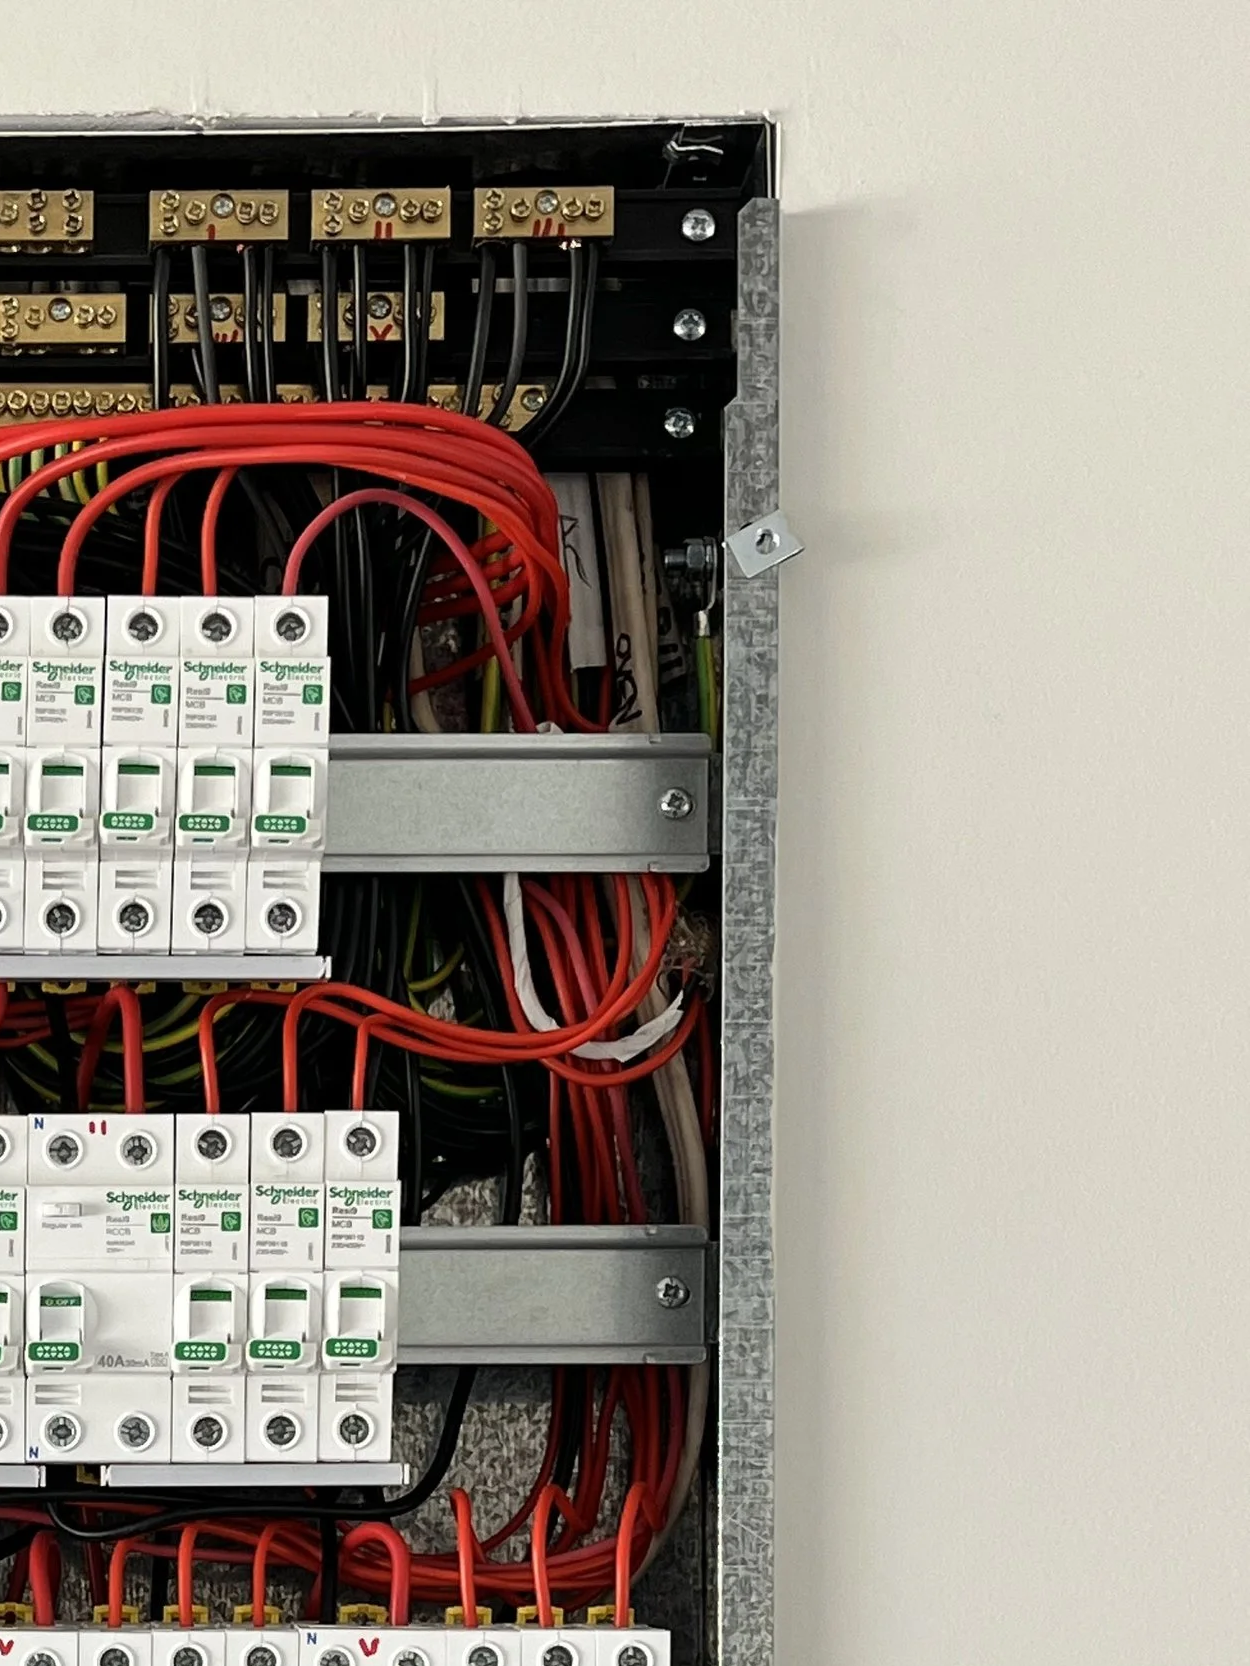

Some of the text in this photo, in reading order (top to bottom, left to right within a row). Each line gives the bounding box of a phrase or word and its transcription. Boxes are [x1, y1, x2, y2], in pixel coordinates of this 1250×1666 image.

[32, 660, 96, 680] Schneider
[109, 660, 173, 680] Schneider
[183, 661, 247, 681] Schneider
[259, 661, 324, 681] Schneider
[34, 1117, 44, 1129] N
[106, 1191, 170, 1211] Schneider
[178, 1189, 242, 1209] Schneider
[255, 1185, 319, 1205] Schneider
[329, 1187, 393, 1207] Schneider
[97, 1354, 125, 1368] 40A
[29, 1447, 39, 1458] N
[307, 1633, 317, 1645] N
[359, 1638, 380, 1657] V
